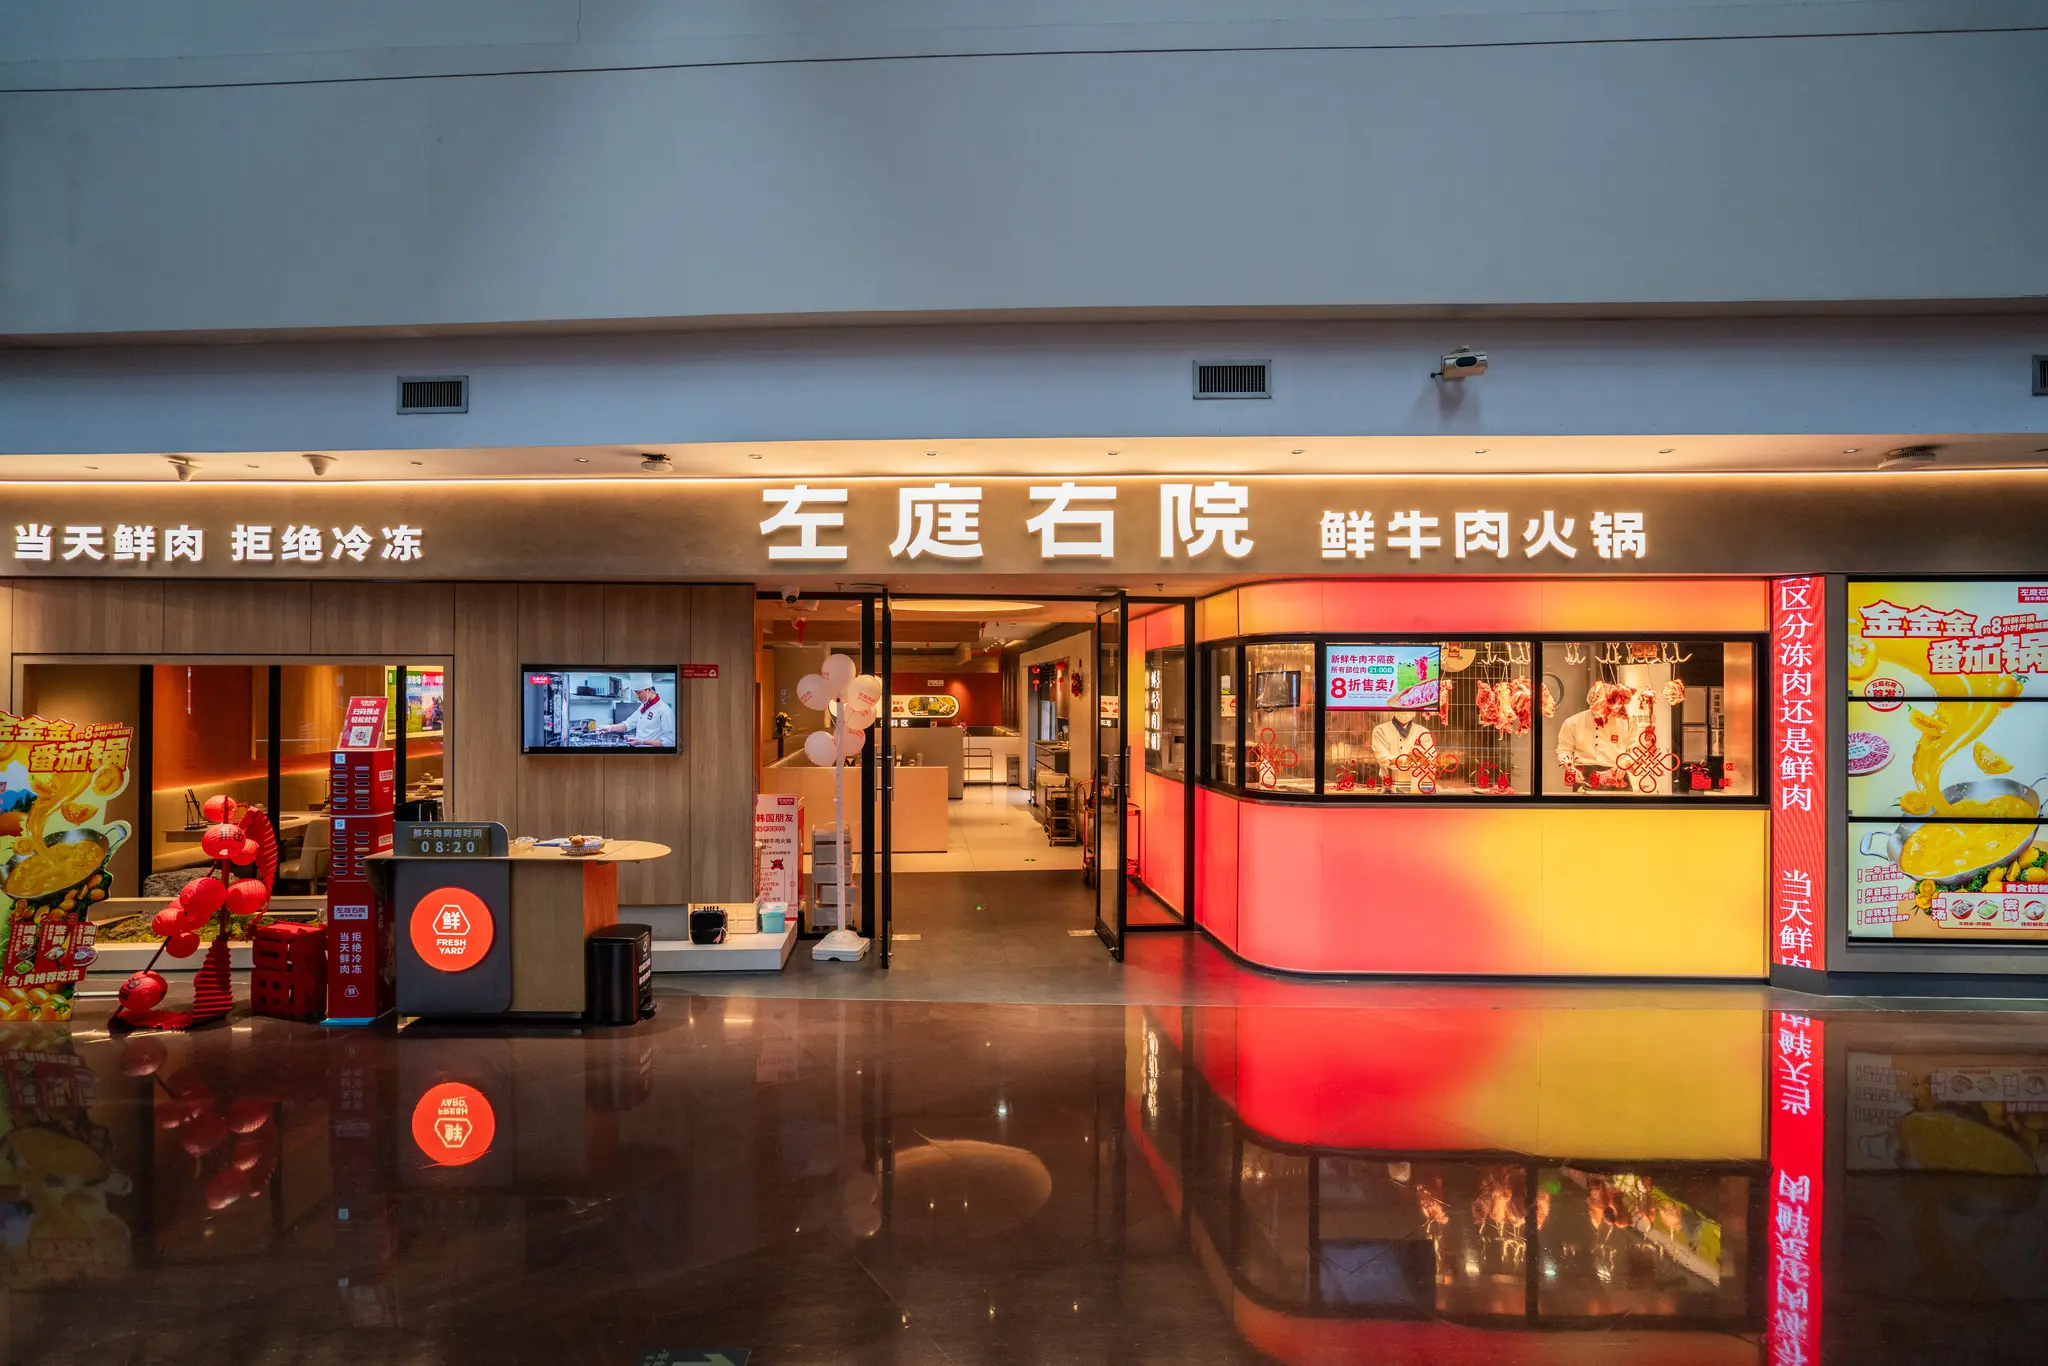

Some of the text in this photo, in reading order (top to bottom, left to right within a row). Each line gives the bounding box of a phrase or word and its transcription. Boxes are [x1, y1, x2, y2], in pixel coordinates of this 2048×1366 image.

[759, 482, 1254, 560] 左庭右院
[1320, 509, 1646, 559] 鲜牛肉火锅
[13, 523, 424, 562] 当天鲜肉 拒绝冷冻
[2020, 588, 2048, 596] 左庭右
[1858, 600, 1977, 638] 金金金
[1330, 655, 1395, 664] 新鲜牛肉不隔夜
[1928, 632, 2048, 674] 番茄锅
[1779, 577, 1813, 811] 区分冻肉还是鲜肉
[413, 828, 482, 838] 鲜牛肉到店时间
[421, 841, 475, 852] 08:20
[442, 911, 460, 930] 鲜
[340, 932, 349, 974] 当天鲜肉
[352, 932, 362, 974] 拒绝冷冻
[436, 938, 467, 946] FRESH
